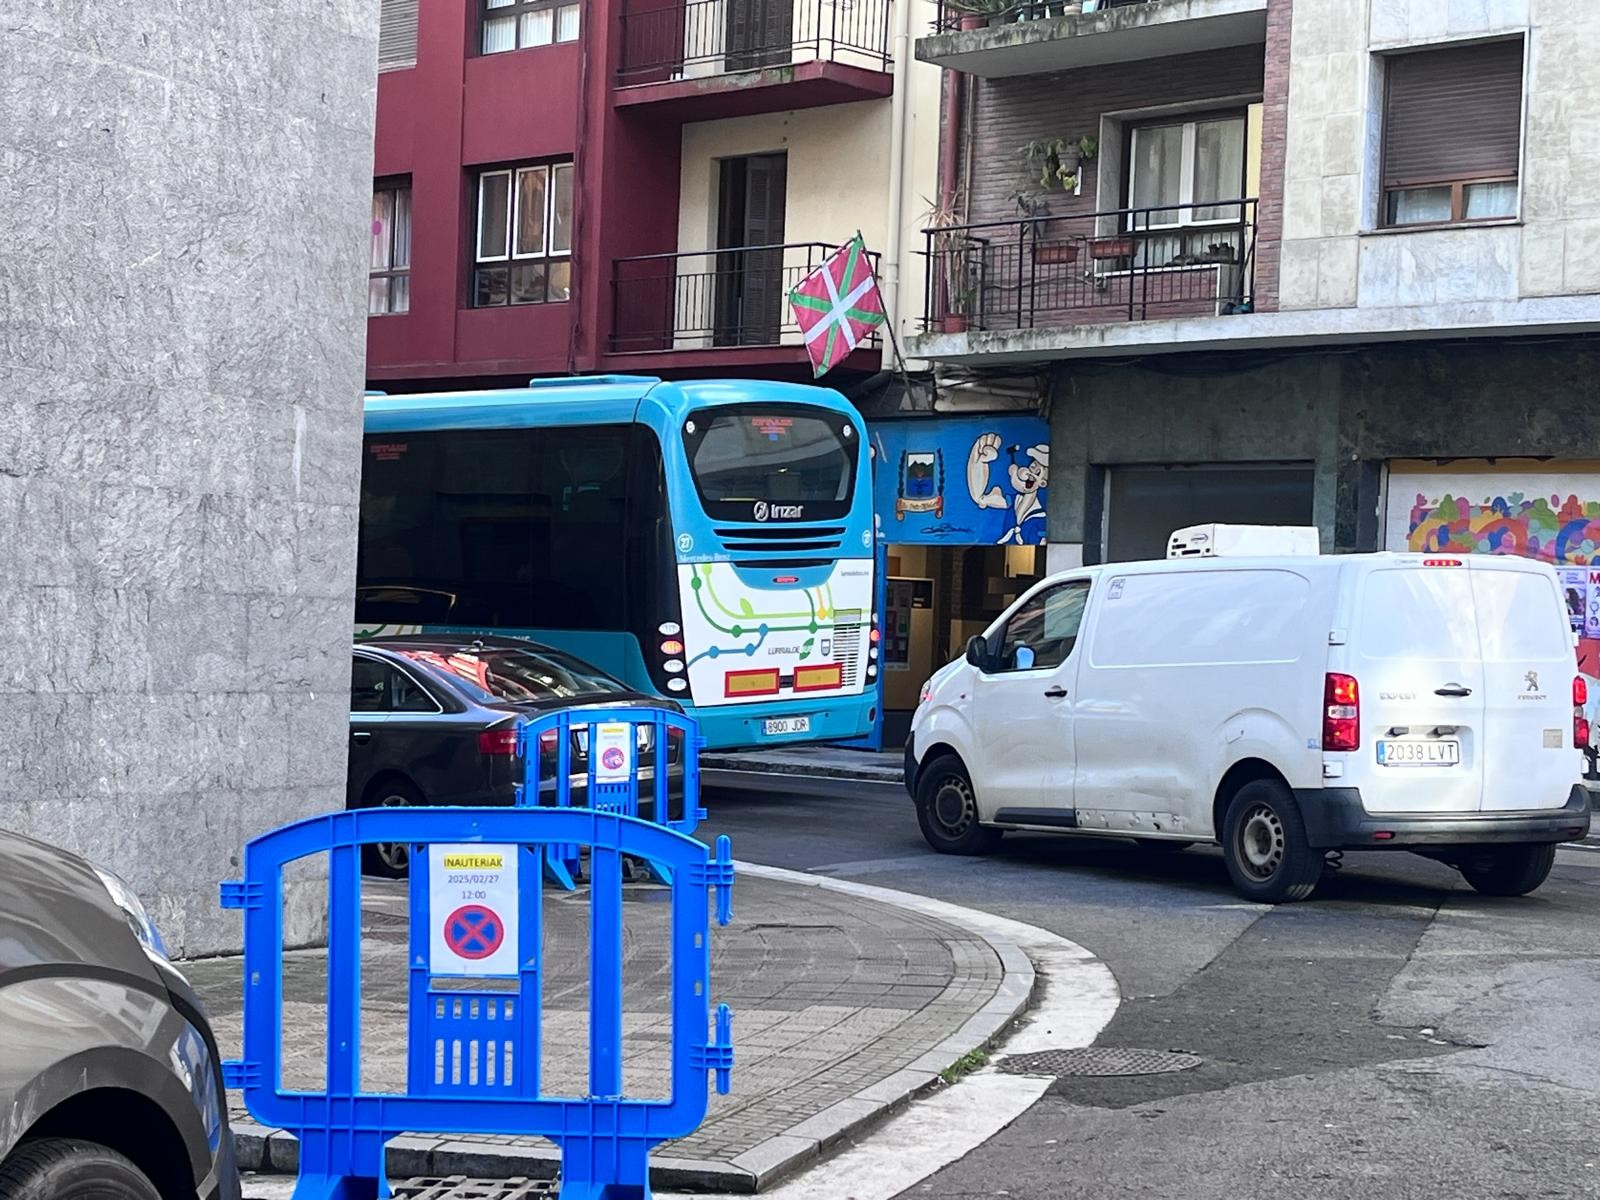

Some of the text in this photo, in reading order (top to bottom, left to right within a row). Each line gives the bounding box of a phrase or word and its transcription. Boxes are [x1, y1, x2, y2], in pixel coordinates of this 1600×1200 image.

[1387, 744, 1454, 761] 2038 LVT
[444, 858, 502, 867] INAUTERIAK
[448, 874, 499, 884] 2025/02/27
[462, 890, 486, 899] 12:00
